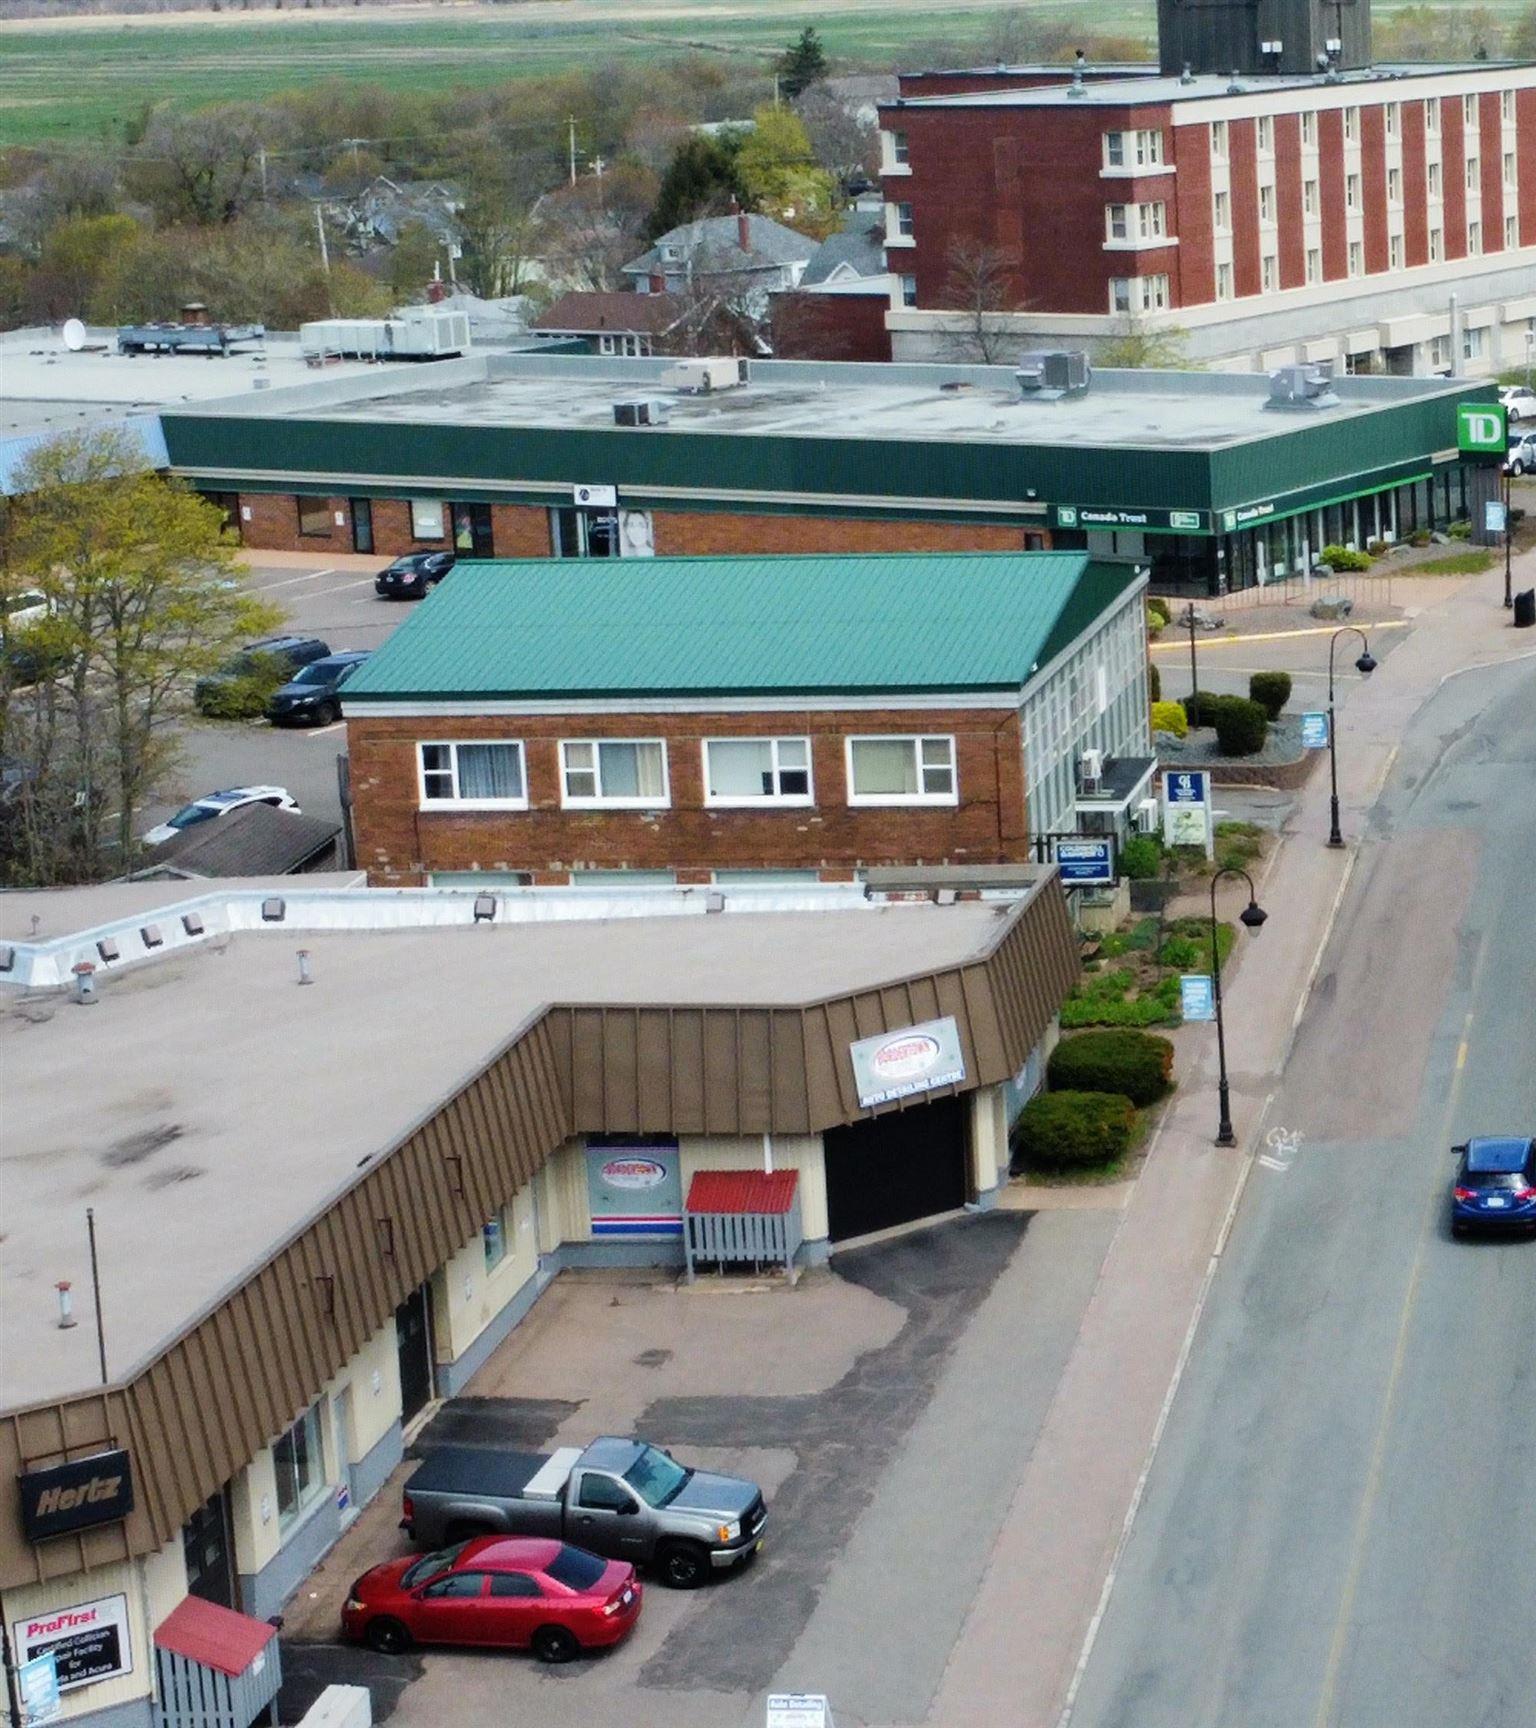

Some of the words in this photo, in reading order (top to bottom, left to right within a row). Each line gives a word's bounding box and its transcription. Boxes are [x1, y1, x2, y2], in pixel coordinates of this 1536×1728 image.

[1461, 412, 1501, 443] TD
[1081, 511, 1118, 522] Canada
[1119, 512, 1147, 524] Trust
[36, 1475, 122, 1517] Hertz
[27, 1608, 97, 1638] ProFirst
[73, 1630, 111, 1646] Collision
[73, 1643, 104, 1658] Facility
[88, 1662, 113, 1675] Acura
